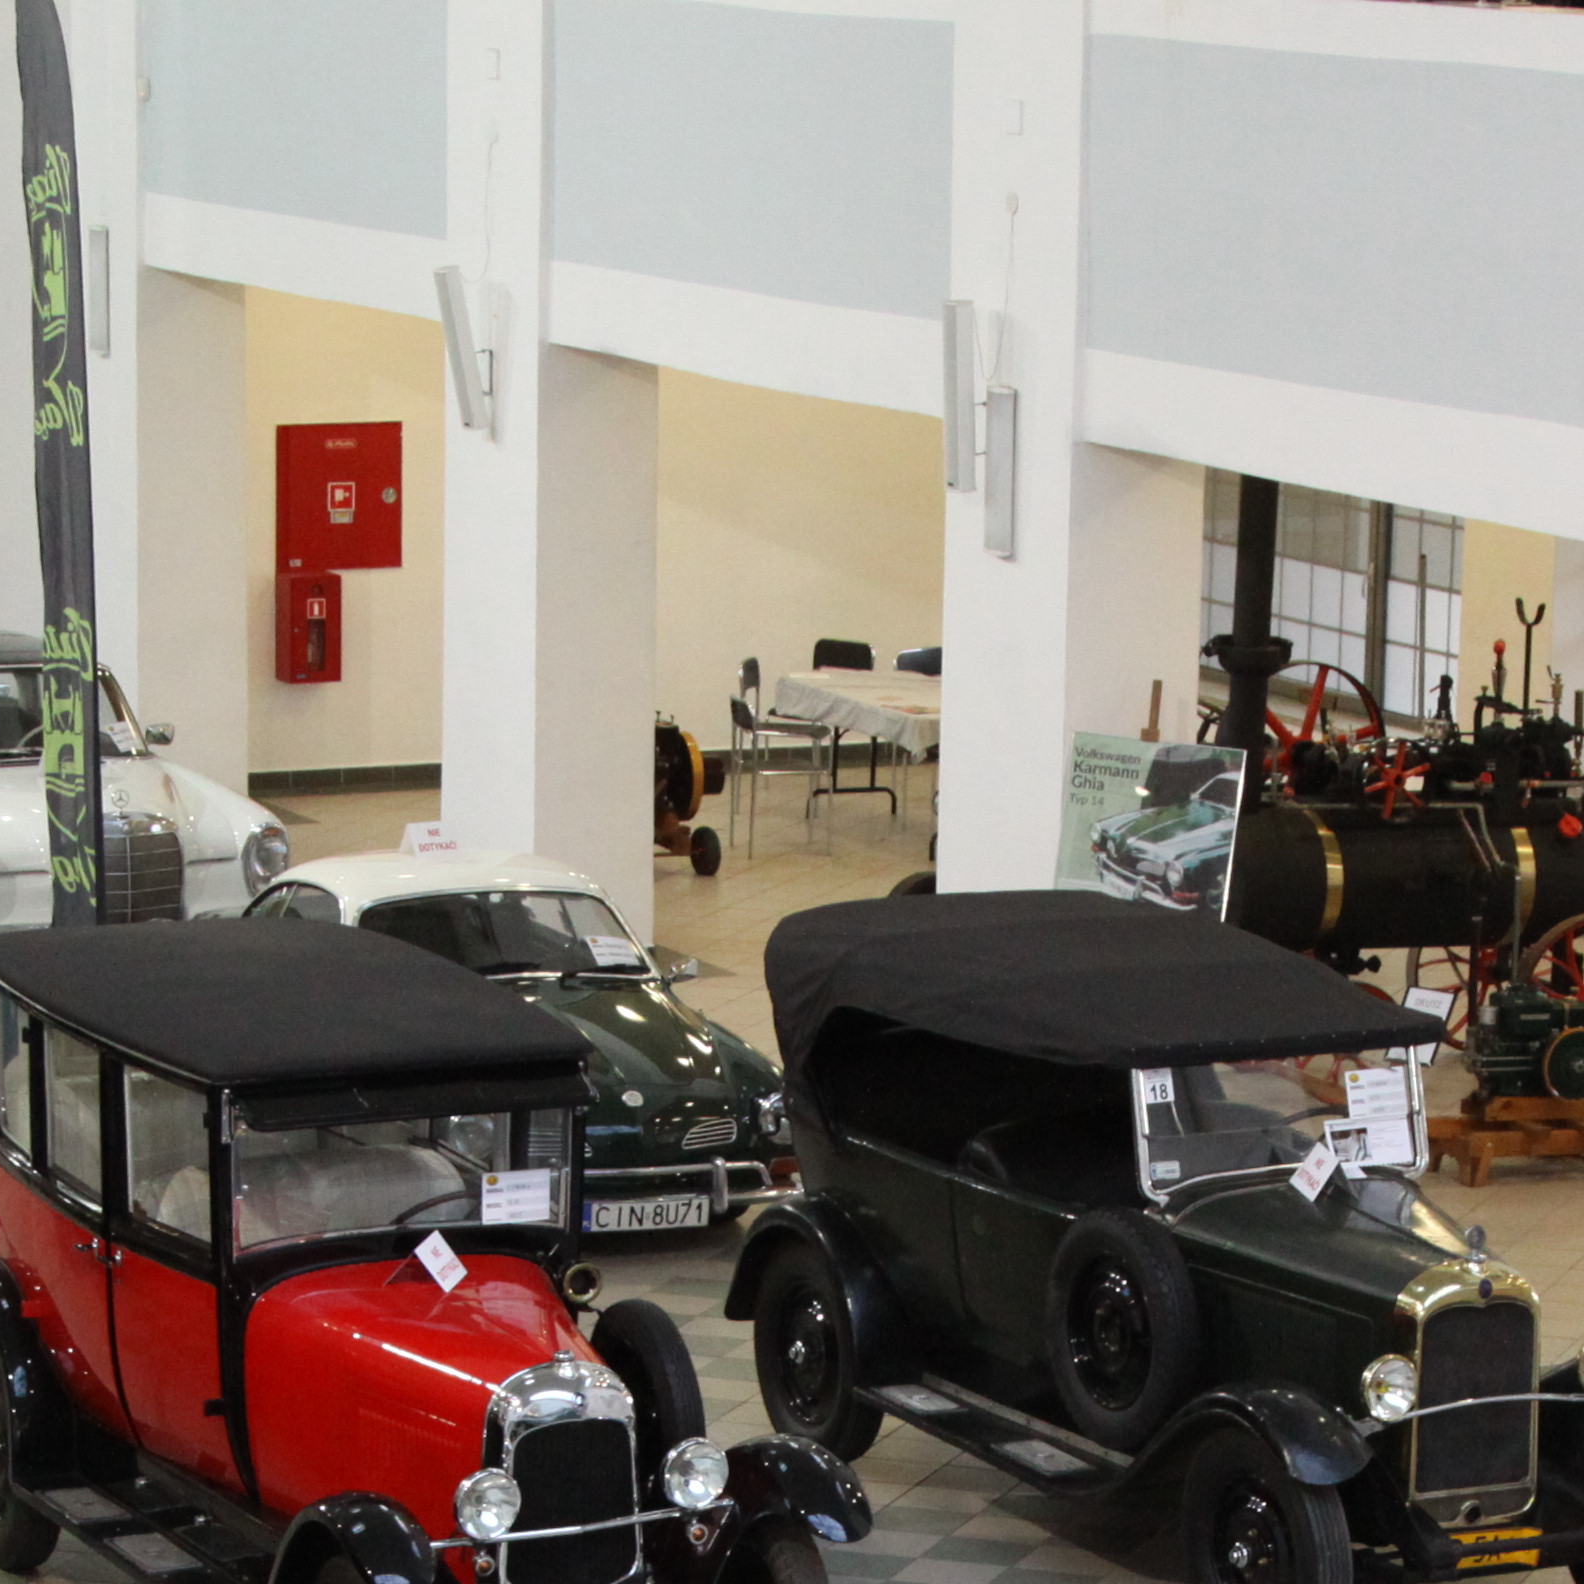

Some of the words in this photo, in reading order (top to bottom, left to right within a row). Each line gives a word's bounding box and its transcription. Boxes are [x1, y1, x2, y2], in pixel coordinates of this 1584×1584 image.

[1074, 747, 1141, 765] Volkswagen
[1073, 761, 1140, 779] Karmann
[1071, 775, 1105, 791] Ghia
[1070, 793, 1088, 806] Typ
[1091, 794, 1105, 805] 14
[1151, 1083, 1168, 1101] 18
[596, 1205, 645, 1228] CIN
[652, 1199, 703, 1226] 8U71
